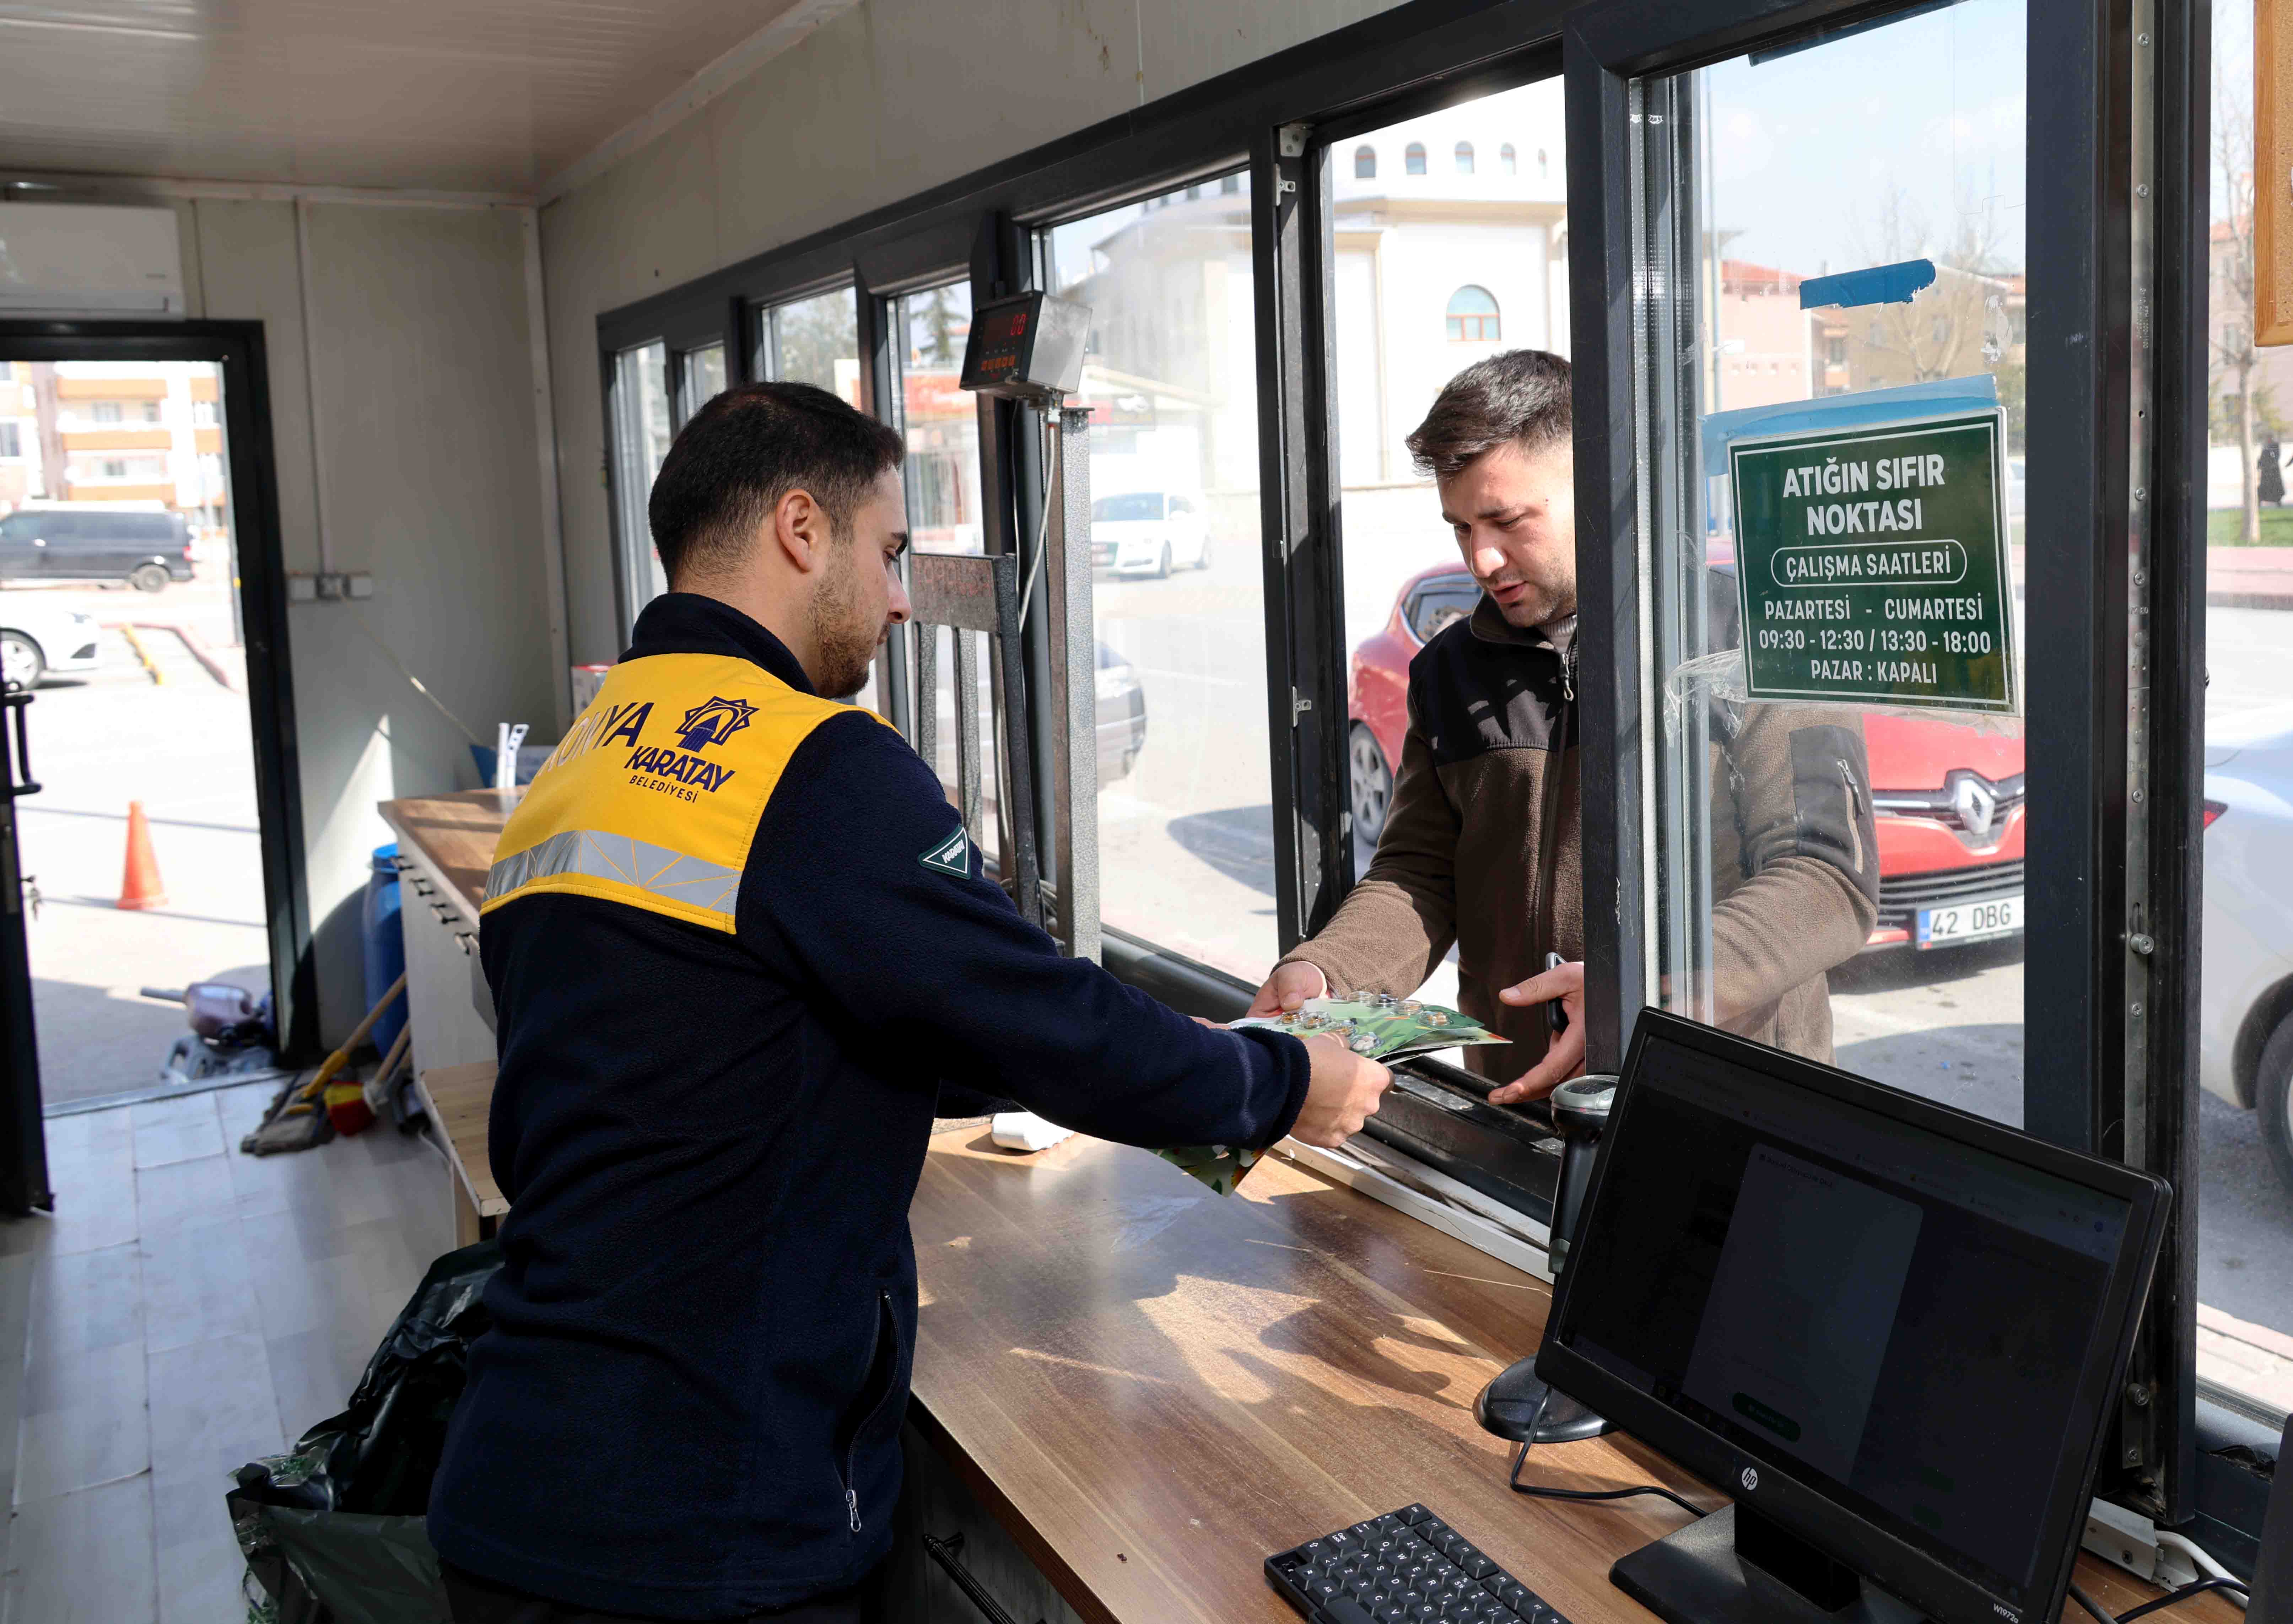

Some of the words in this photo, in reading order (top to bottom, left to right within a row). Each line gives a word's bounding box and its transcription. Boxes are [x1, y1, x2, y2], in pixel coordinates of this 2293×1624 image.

[1783, 457, 1869, 498] ATIĞIN
[1876, 454, 1946, 490] SIFIR
[1807, 498, 1922, 535] NOKTASI
[1786, 555, 1861, 582] ÇALIŞMA
[1867, 545, 1950, 575] SAATLERİ
[1765, 594, 1850, 620] PAZARTESİ
[1885, 592, 1982, 620] CUMARTESİ
[1759, 630, 1805, 649] 09:30
[1820, 630, 1864, 650] 12:30
[1870, 628, 1875, 652] /
[1881, 630, 1926, 652] 13:30
[1943, 631, 1991, 653] 18:00
[1811, 660, 1863, 680] PAZAR
[1877, 661, 1937, 684] KAPALI
[624, 746, 736, 793] KARATAY
[629, 775, 699, 803] BELEDİYESİ
[1933, 912, 1958, 935] 42
[1973, 903, 2011, 930] DBG
